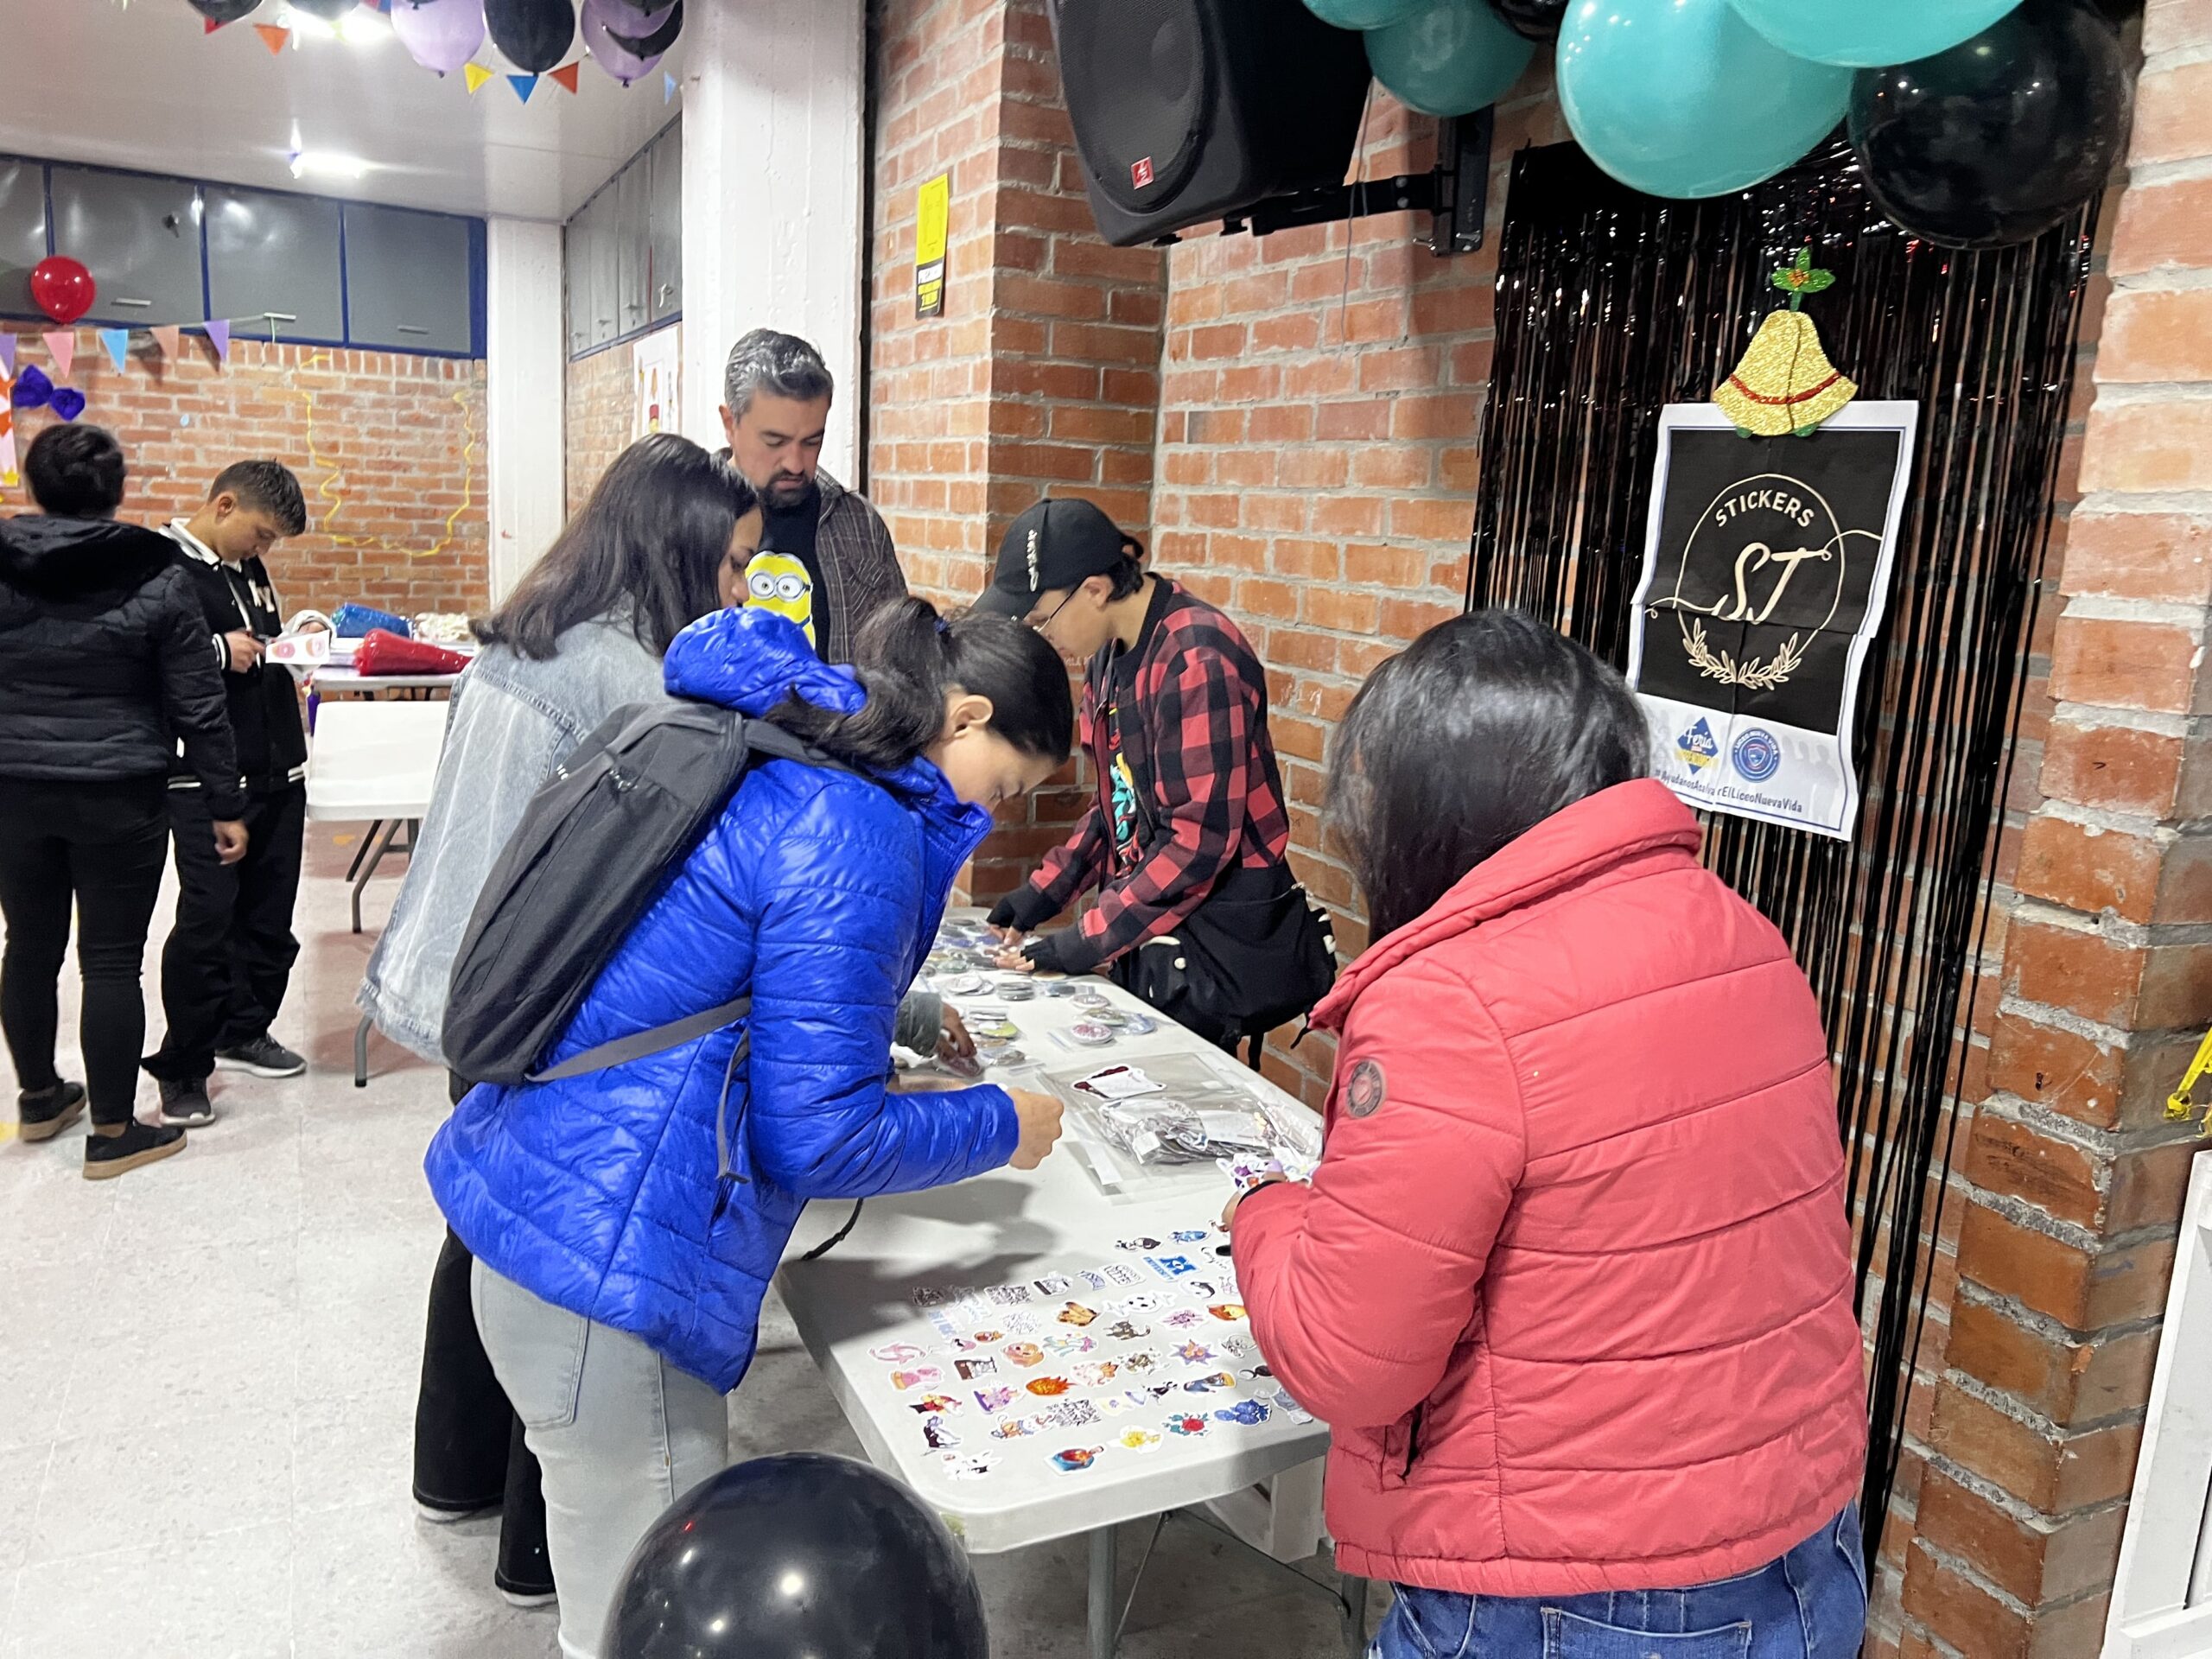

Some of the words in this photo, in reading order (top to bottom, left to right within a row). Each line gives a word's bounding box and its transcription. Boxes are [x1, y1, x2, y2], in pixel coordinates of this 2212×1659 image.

[1715, 489, 1815, 527] STICKERS
[1711, 542, 1824, 625] ST
[1683, 726, 1713, 750] Feria
